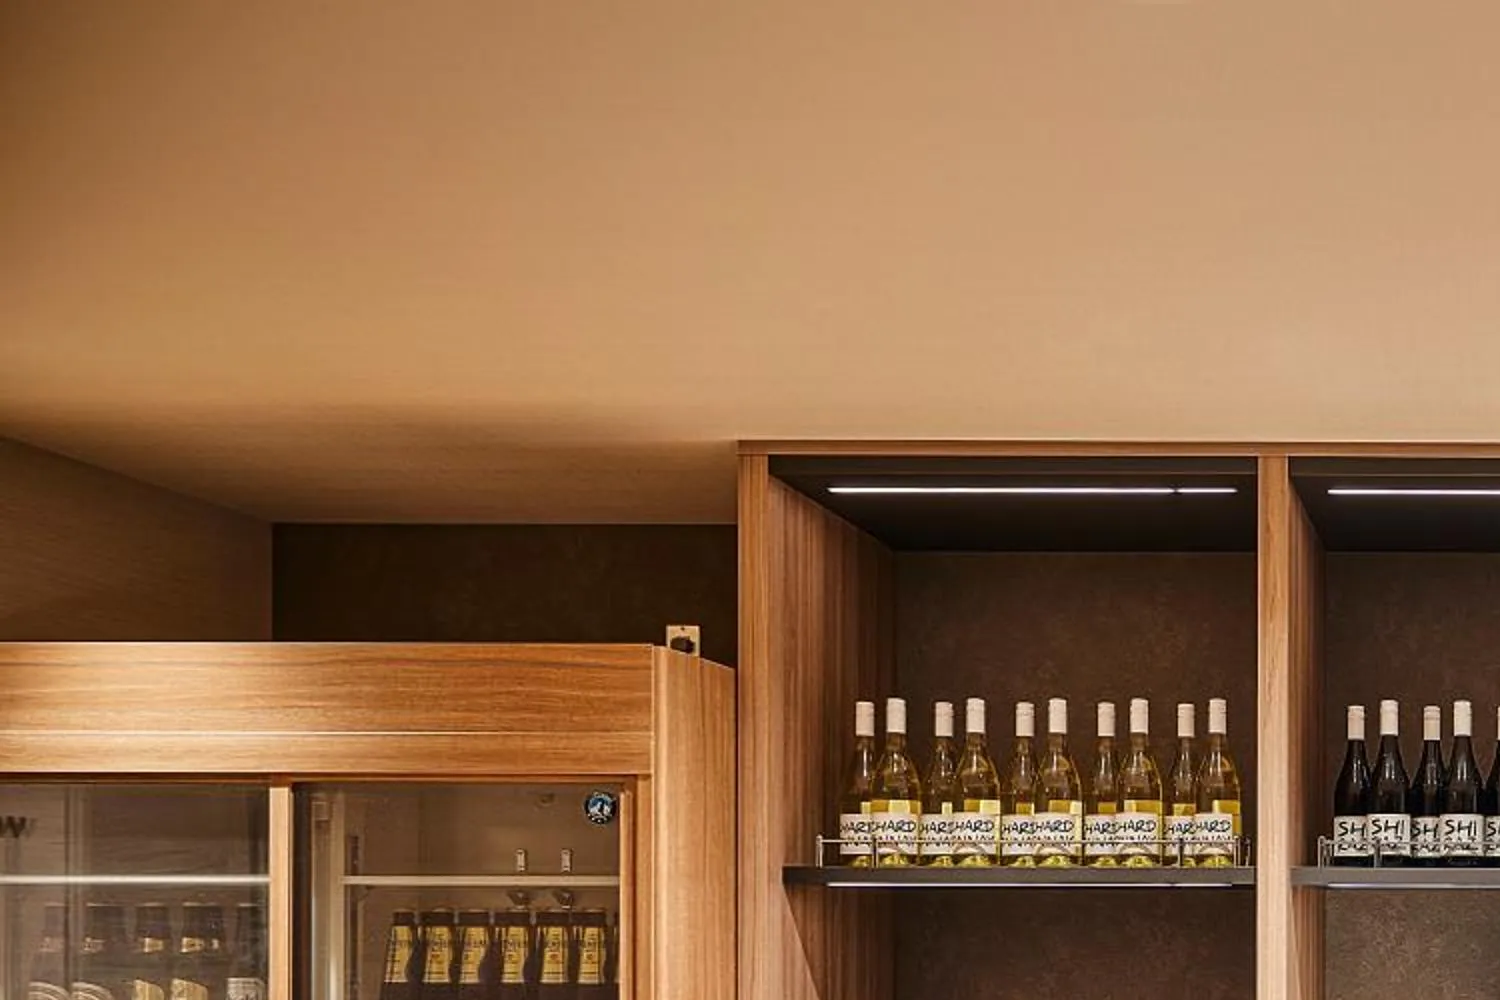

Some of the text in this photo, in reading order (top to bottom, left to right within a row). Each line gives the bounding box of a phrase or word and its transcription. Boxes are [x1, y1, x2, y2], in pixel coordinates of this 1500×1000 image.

[1338, 821, 1367, 837] SH
[1371, 819, 1405, 834] SHI
[1444, 819, 1477, 836] SHI
